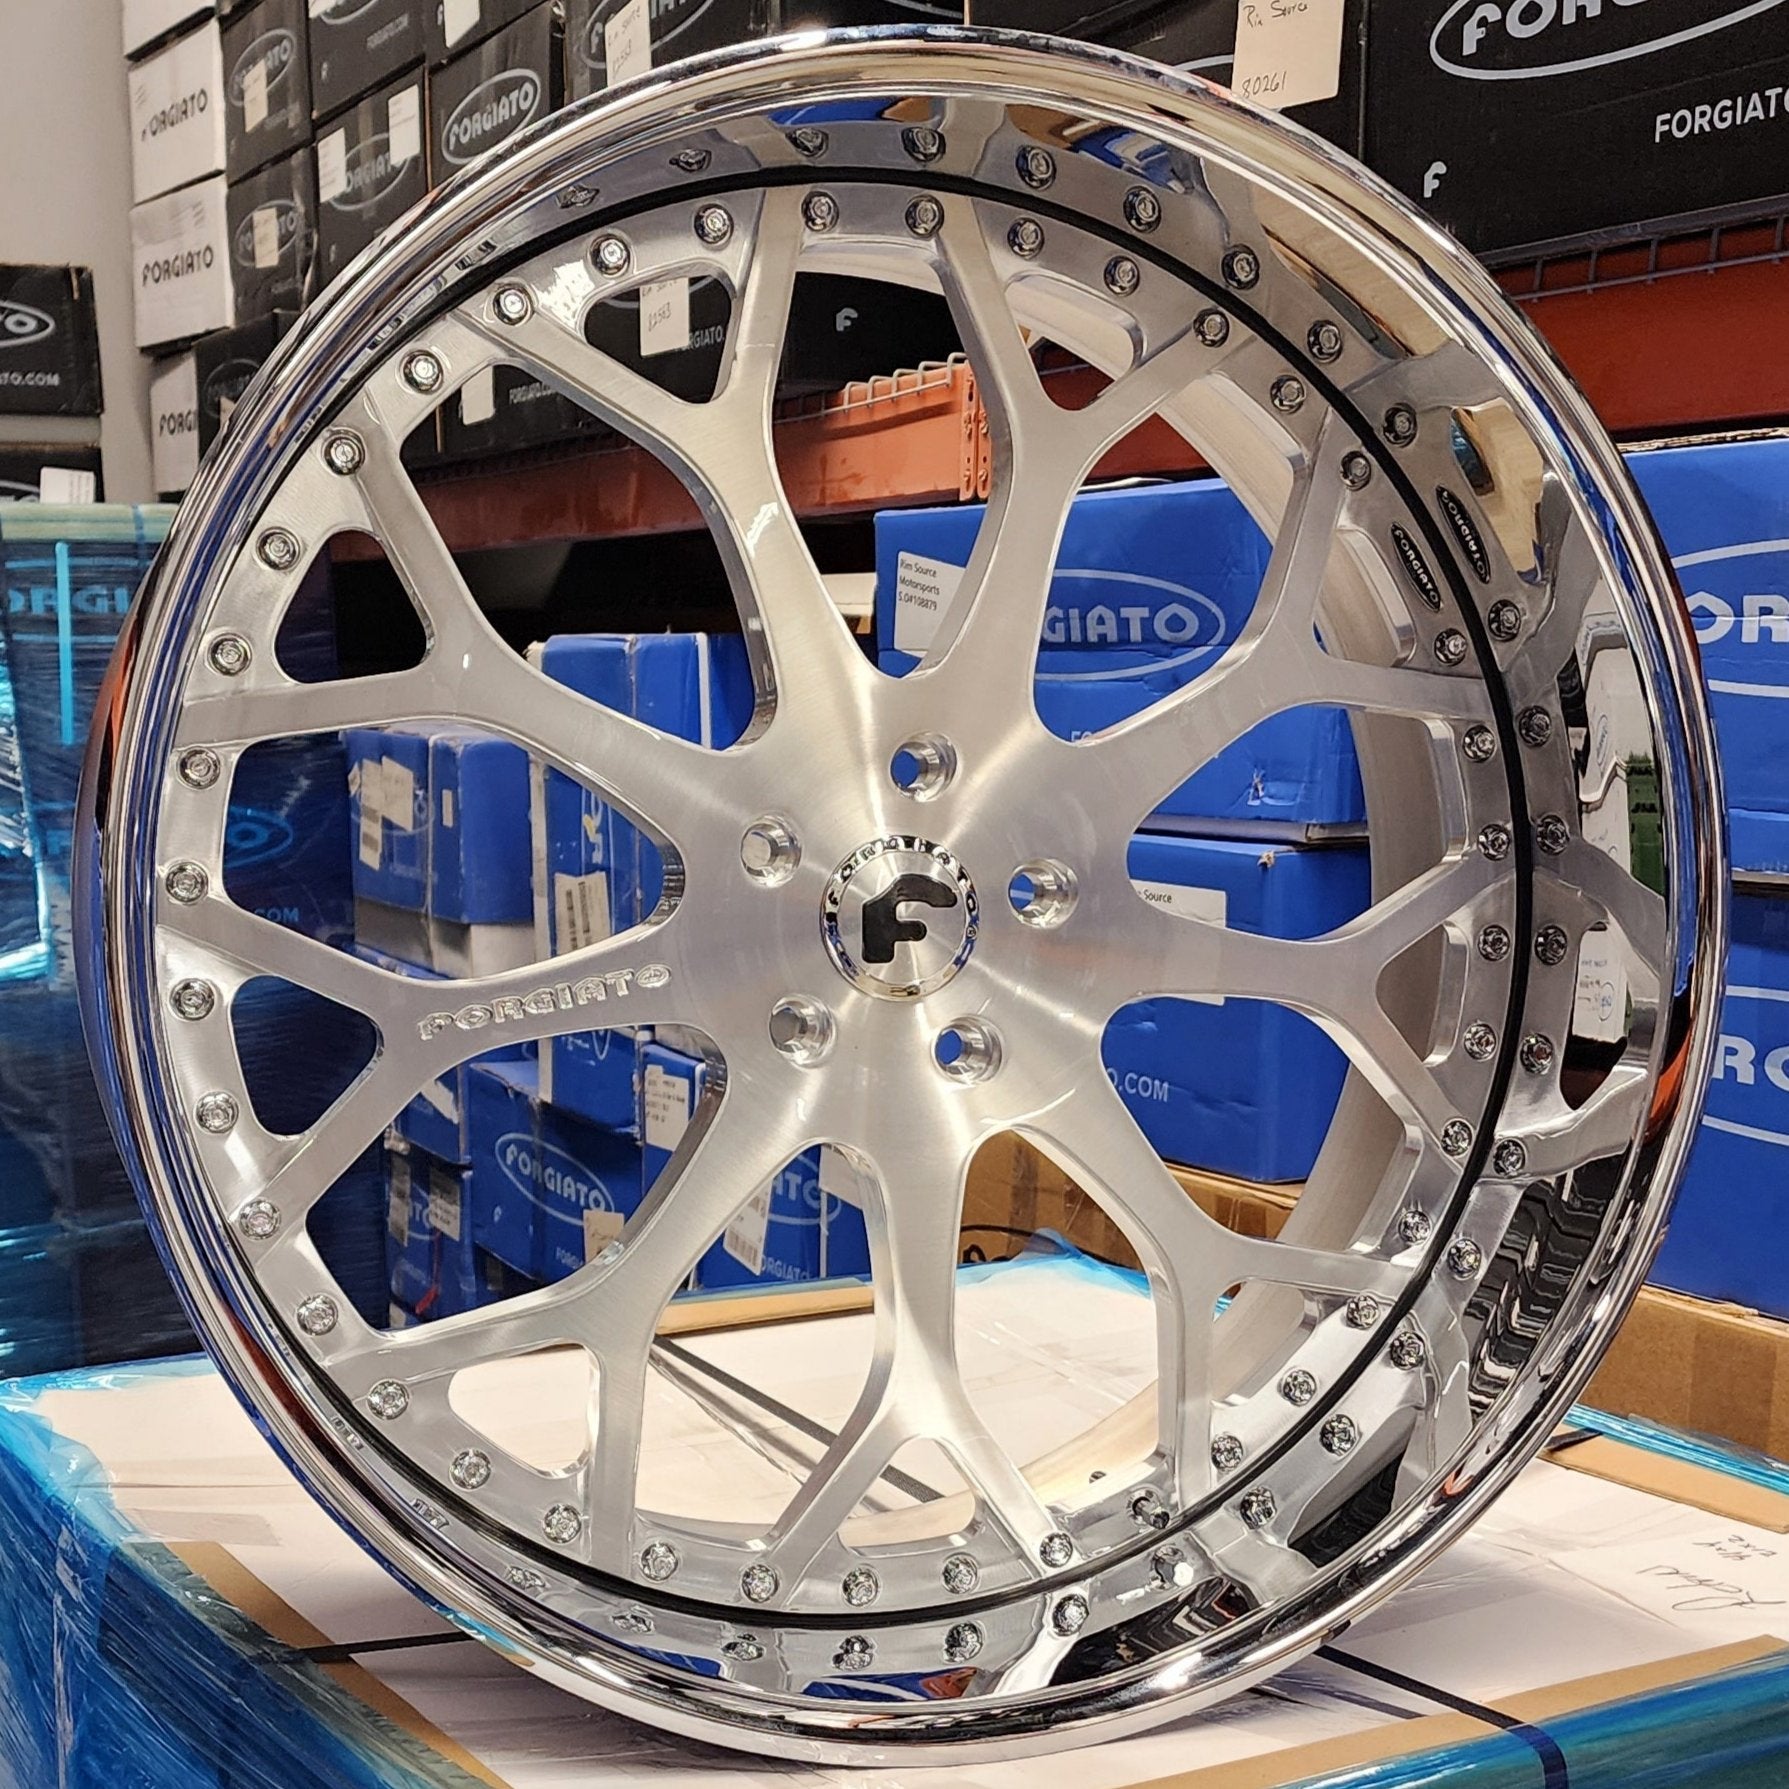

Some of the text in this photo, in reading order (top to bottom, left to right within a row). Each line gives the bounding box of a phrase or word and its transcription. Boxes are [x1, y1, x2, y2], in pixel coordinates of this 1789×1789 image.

[1242, 70, 1287, 98] 80261
[449, 82, 534, 151] FORGIATO
[1654, 87, 1789, 143] FORGIAT
[142, 245, 214, 287] FORGIATO
[899, 575, 940, 596] Motorsports
[914, 562, 937, 578] Source
[1393, 528, 1439, 603] FORGIATO
[417, 963, 671, 1041] FORGIATO
[505, 1143, 606, 1212] FORGIATO
